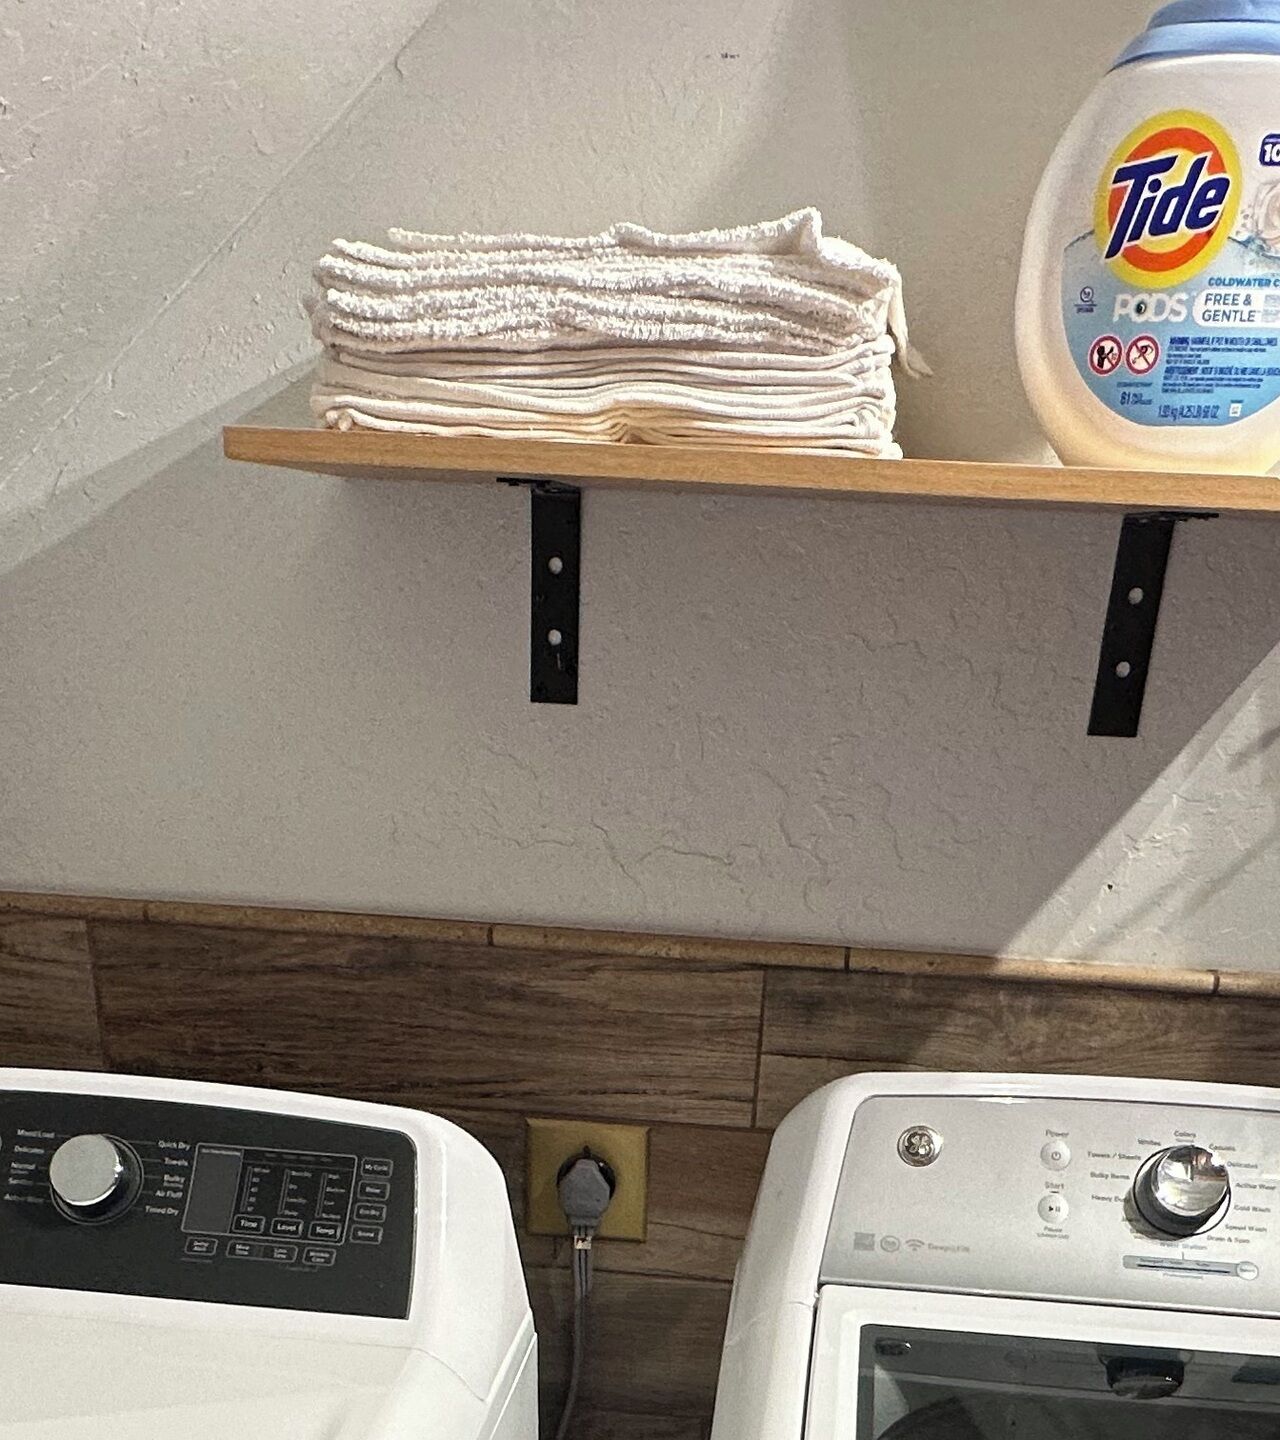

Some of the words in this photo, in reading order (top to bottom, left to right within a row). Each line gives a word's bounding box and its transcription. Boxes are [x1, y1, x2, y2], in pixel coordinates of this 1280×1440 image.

[1105, 155, 1230, 259] Tide
[1208, 277, 1272, 288] COLDWATER
[1204, 292, 1241, 306] FREE
[1243, 293, 1253, 306] &
[1113, 292, 1188, 323] PODS
[1201, 309, 1257, 323] GENTLE
[1045, 1129, 1069, 1138] Power
[1174, 1130, 1197, 1138] Colors
[158, 1140, 178, 1149] Quick
[178, 1141, 191, 1151] Dry
[1227, 1161, 1258, 1170] Delicates
[1090, 1171, 1109, 1180] Bulky
[1044, 1181, 1065, 1189] Start
[1235, 1181, 1259, 1190] Active
[155, 1189, 166, 1197] Air
[166, 1190, 183, 1198] Fluff
[1091, 1194, 1113, 1203] Heavy
[145, 1205, 166, 1214] Timed
[166, 1207, 180, 1216] Dry
[1233, 1204, 1251, 1212] Cold
[240, 1219, 258, 1228] Time
[277, 1223, 297, 1232] Level
[315, 1226, 335, 1236] Temp
